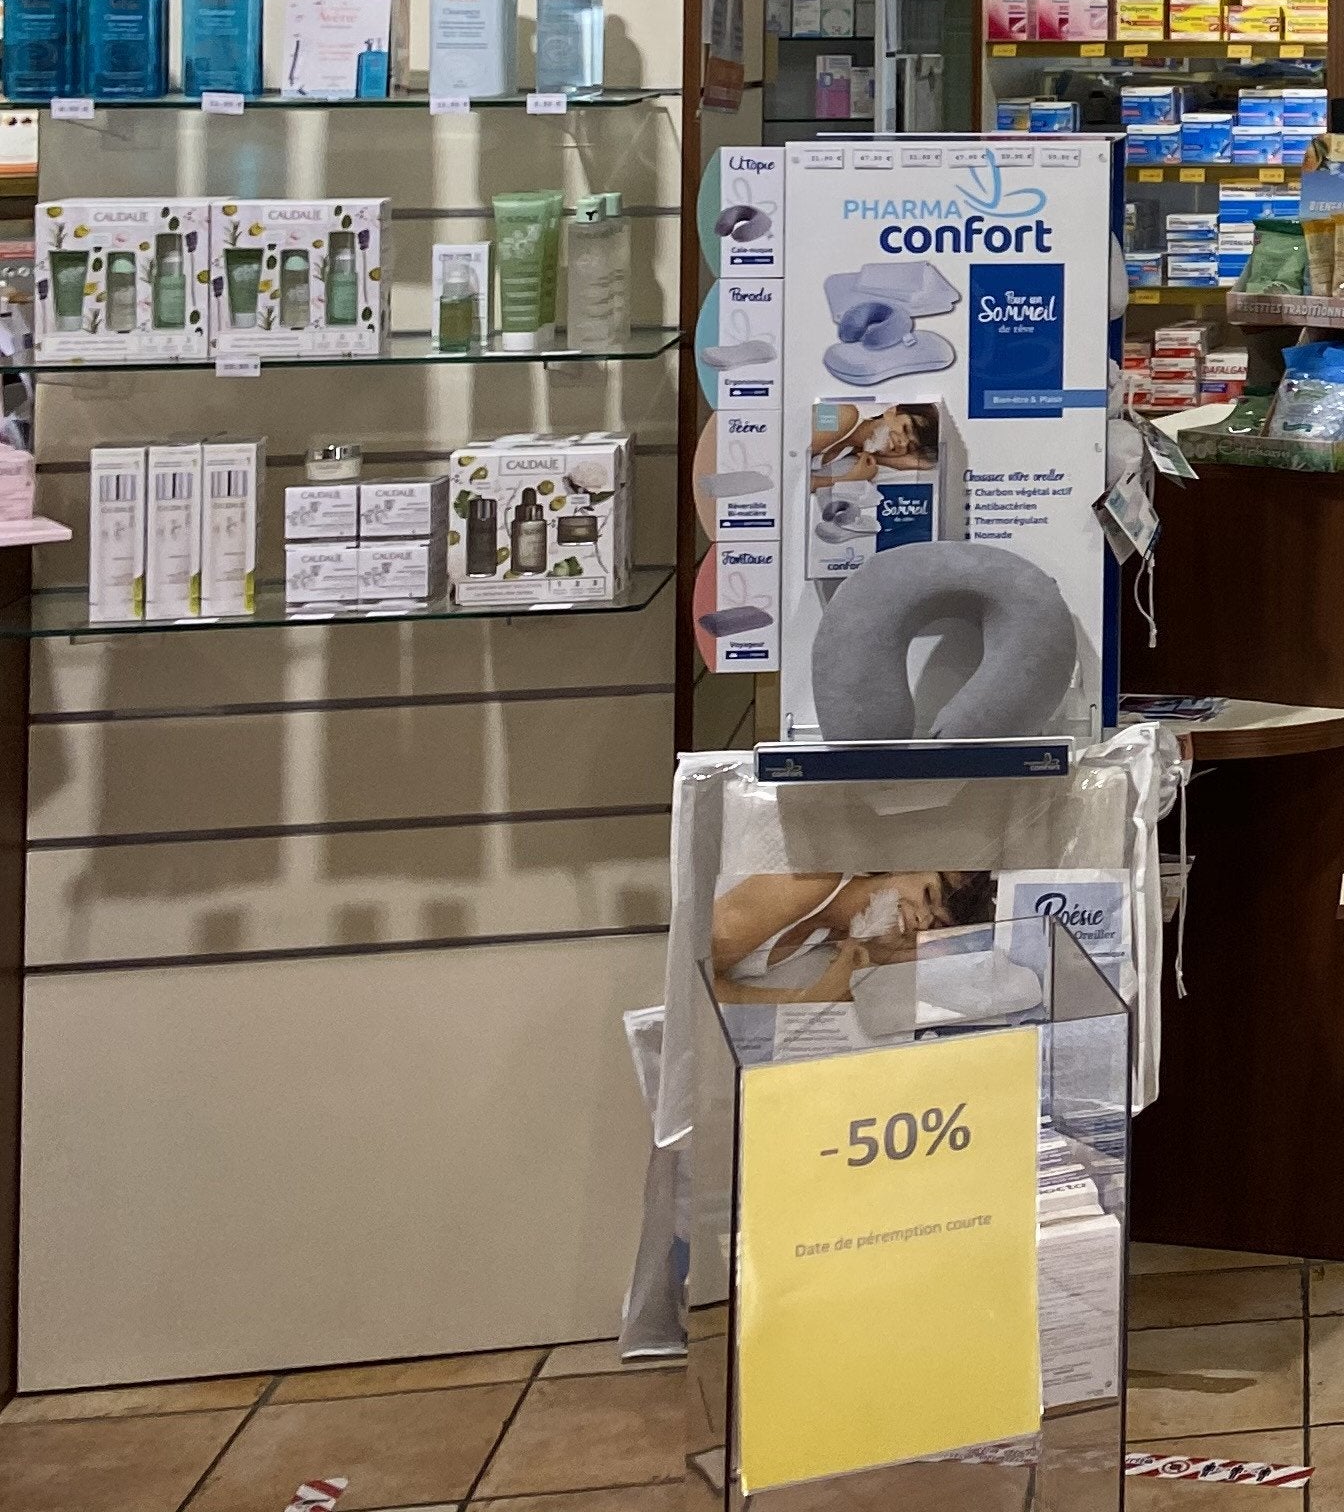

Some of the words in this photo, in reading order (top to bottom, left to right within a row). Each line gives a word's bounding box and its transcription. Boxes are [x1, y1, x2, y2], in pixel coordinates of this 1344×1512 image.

[844, 200, 962, 220] PHARMA
[880, 215, 1052, 254] confort
[978, 295, 1057, 322] Sommeil
[506, 460, 559, 470] CAUDALIE
[975, 488, 1013, 497] Charbon
[974, 502, 1037, 511] Antibactérien
[974, 516, 1048, 526] Thermorégulant
[974, 531, 1012, 539] Nomade
[820, 1102, 971, 1167] -50%
[795, 1242, 830, 1258] Date
[834, 1238, 853, 1252] de
[857, 1224, 942, 1249] péremption
[946, 1215, 992, 1232] courte
